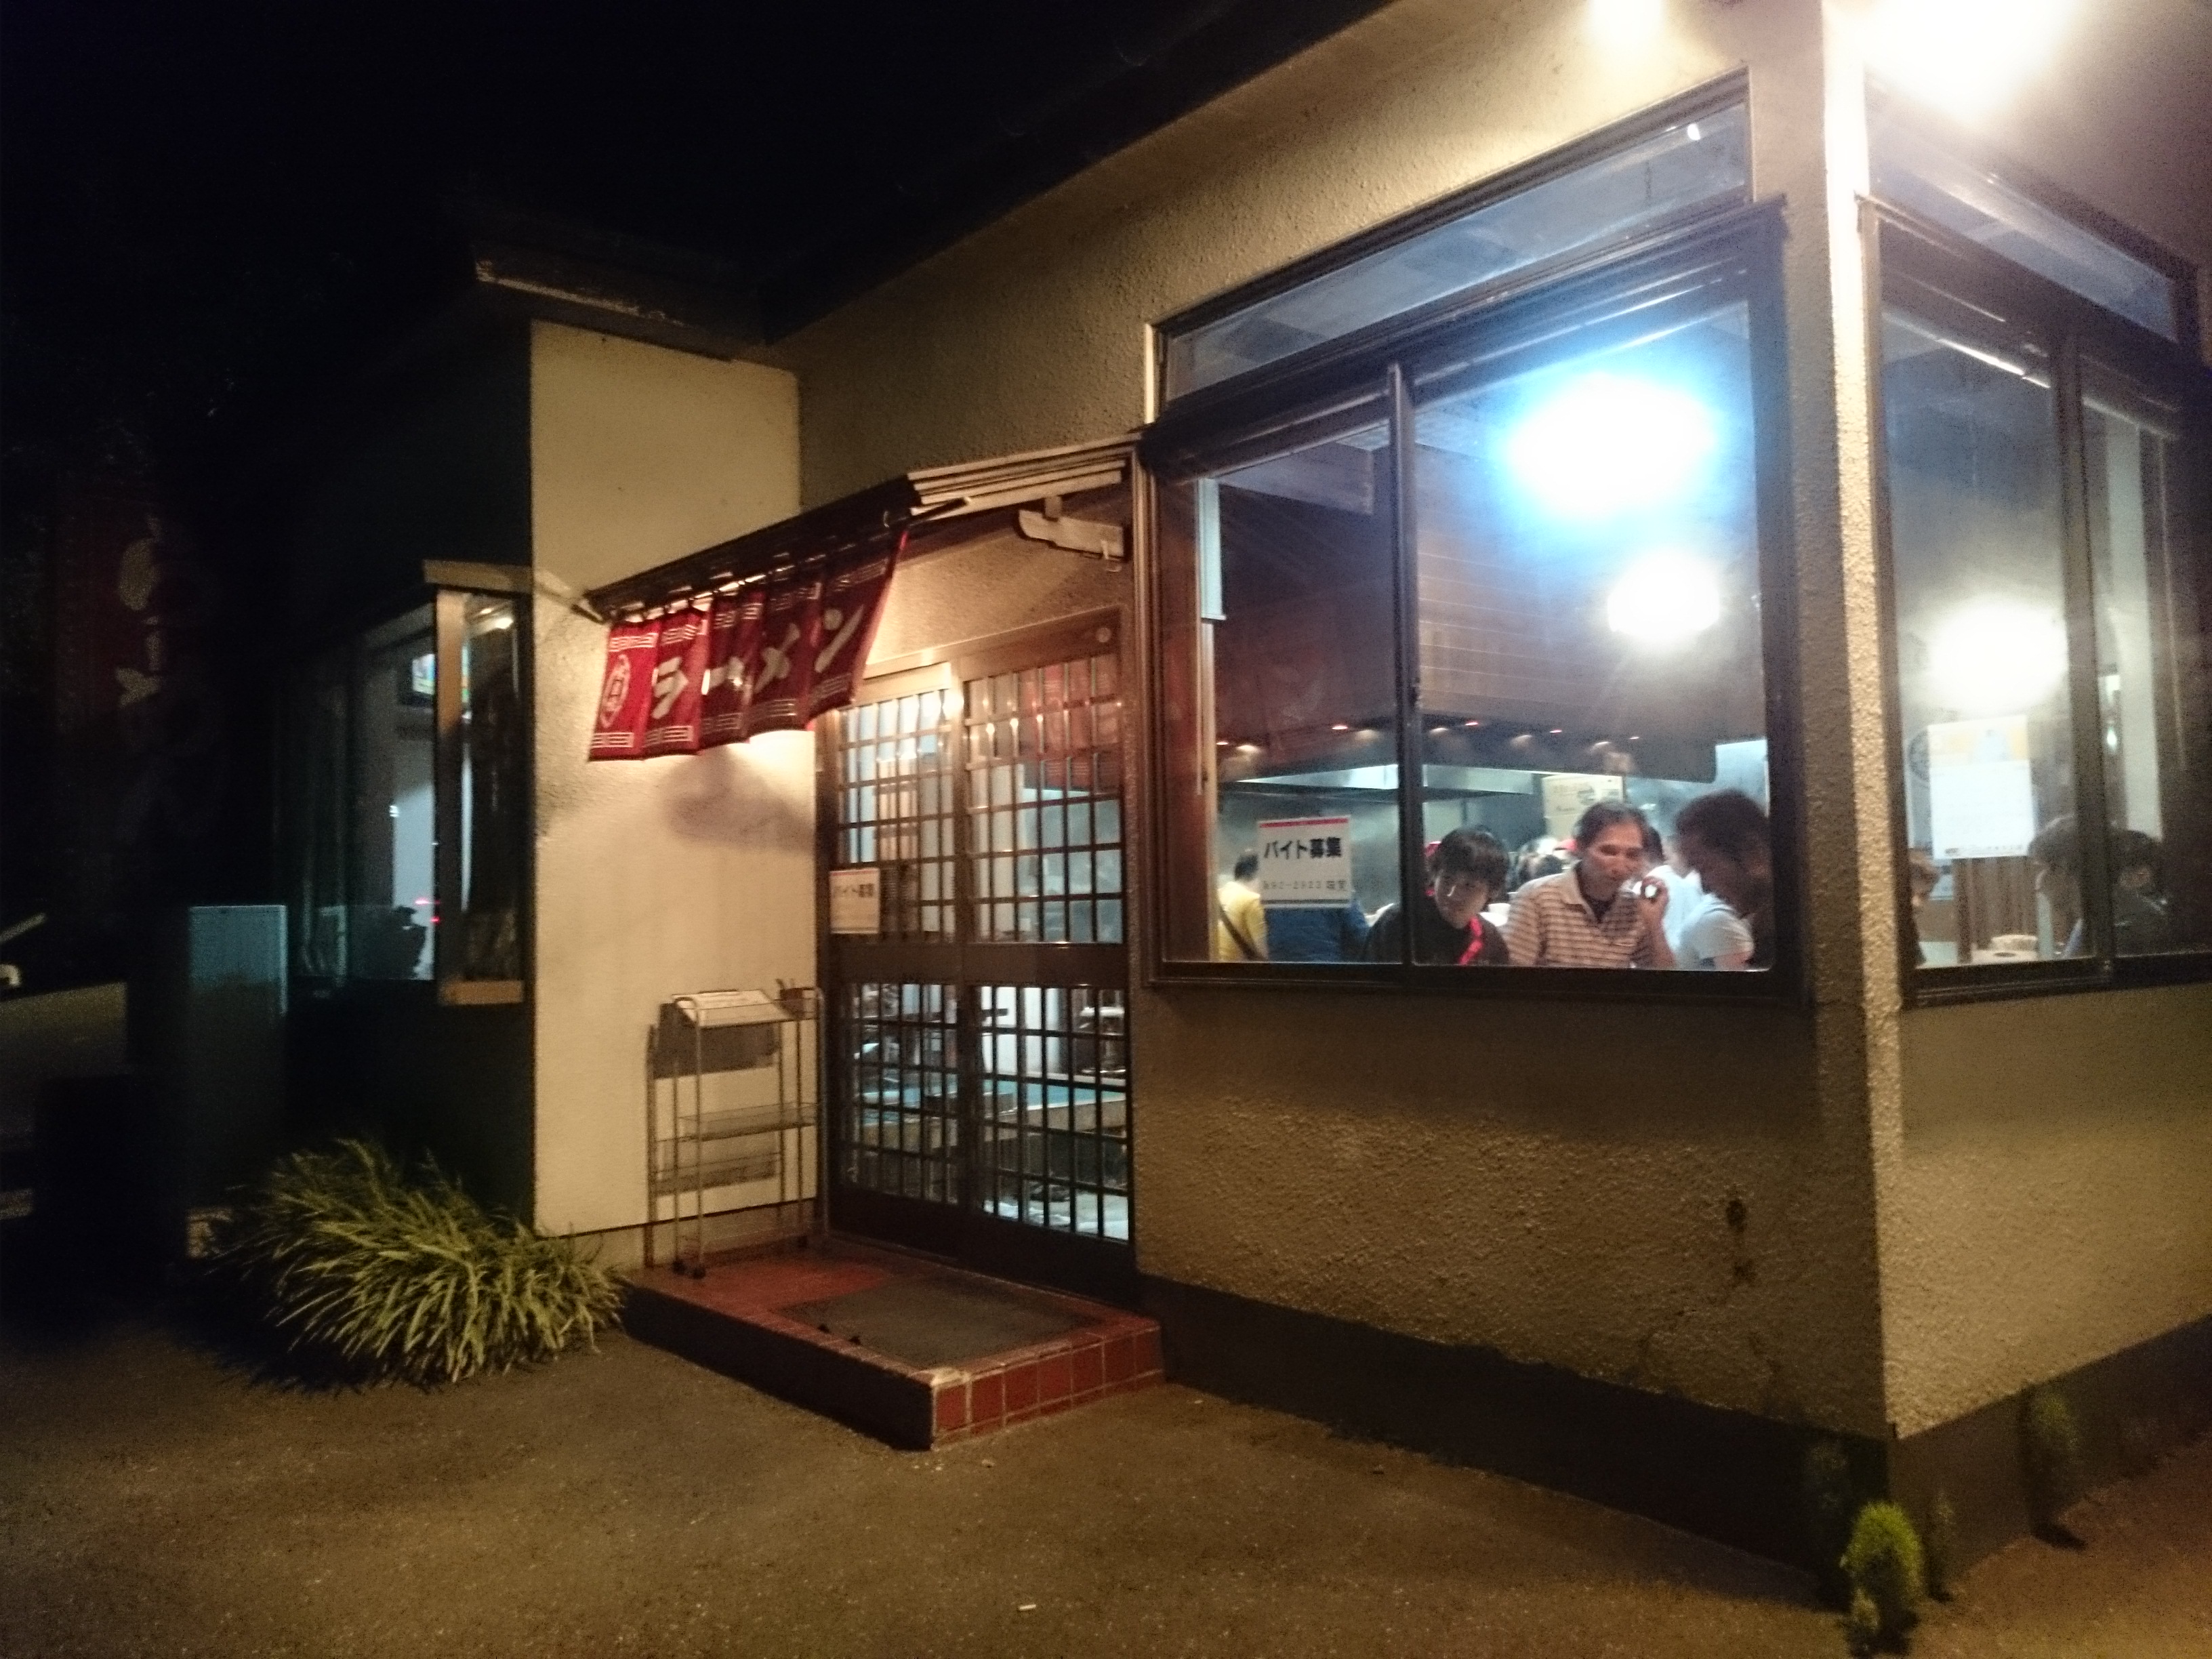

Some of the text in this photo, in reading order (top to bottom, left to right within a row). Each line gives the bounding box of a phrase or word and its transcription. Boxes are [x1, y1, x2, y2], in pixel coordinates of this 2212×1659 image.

[652, 604, 864, 719] ラーメン
[1263, 836, 1341, 859] バイト募集
